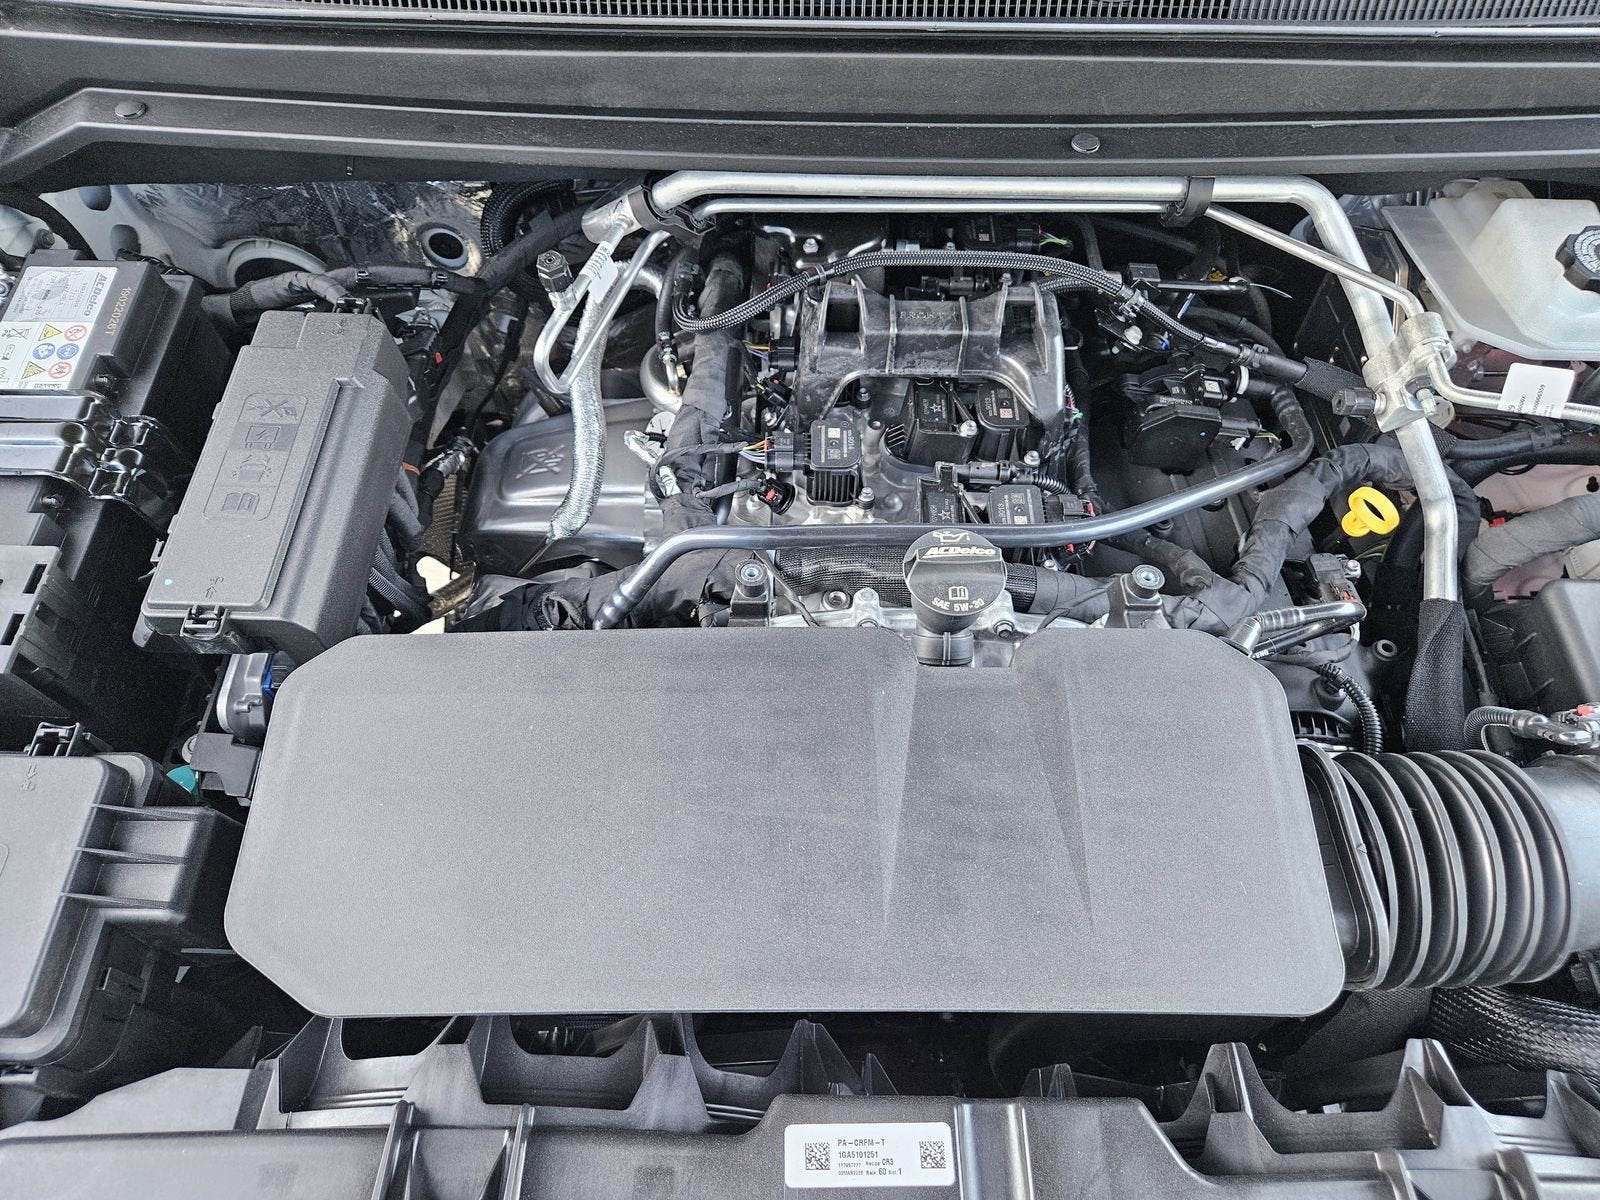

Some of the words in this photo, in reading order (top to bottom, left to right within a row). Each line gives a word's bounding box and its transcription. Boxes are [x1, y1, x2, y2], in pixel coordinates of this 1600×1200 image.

[84, 272, 108, 317] ACDelco
[899, 311, 945, 319] FRONT
[926, 546, 996, 556] ACDelco
[932, 597, 951, 611] SAE
[953, 597, 985, 612] 5W-30
[881, 1158, 894, 1166] CR3
